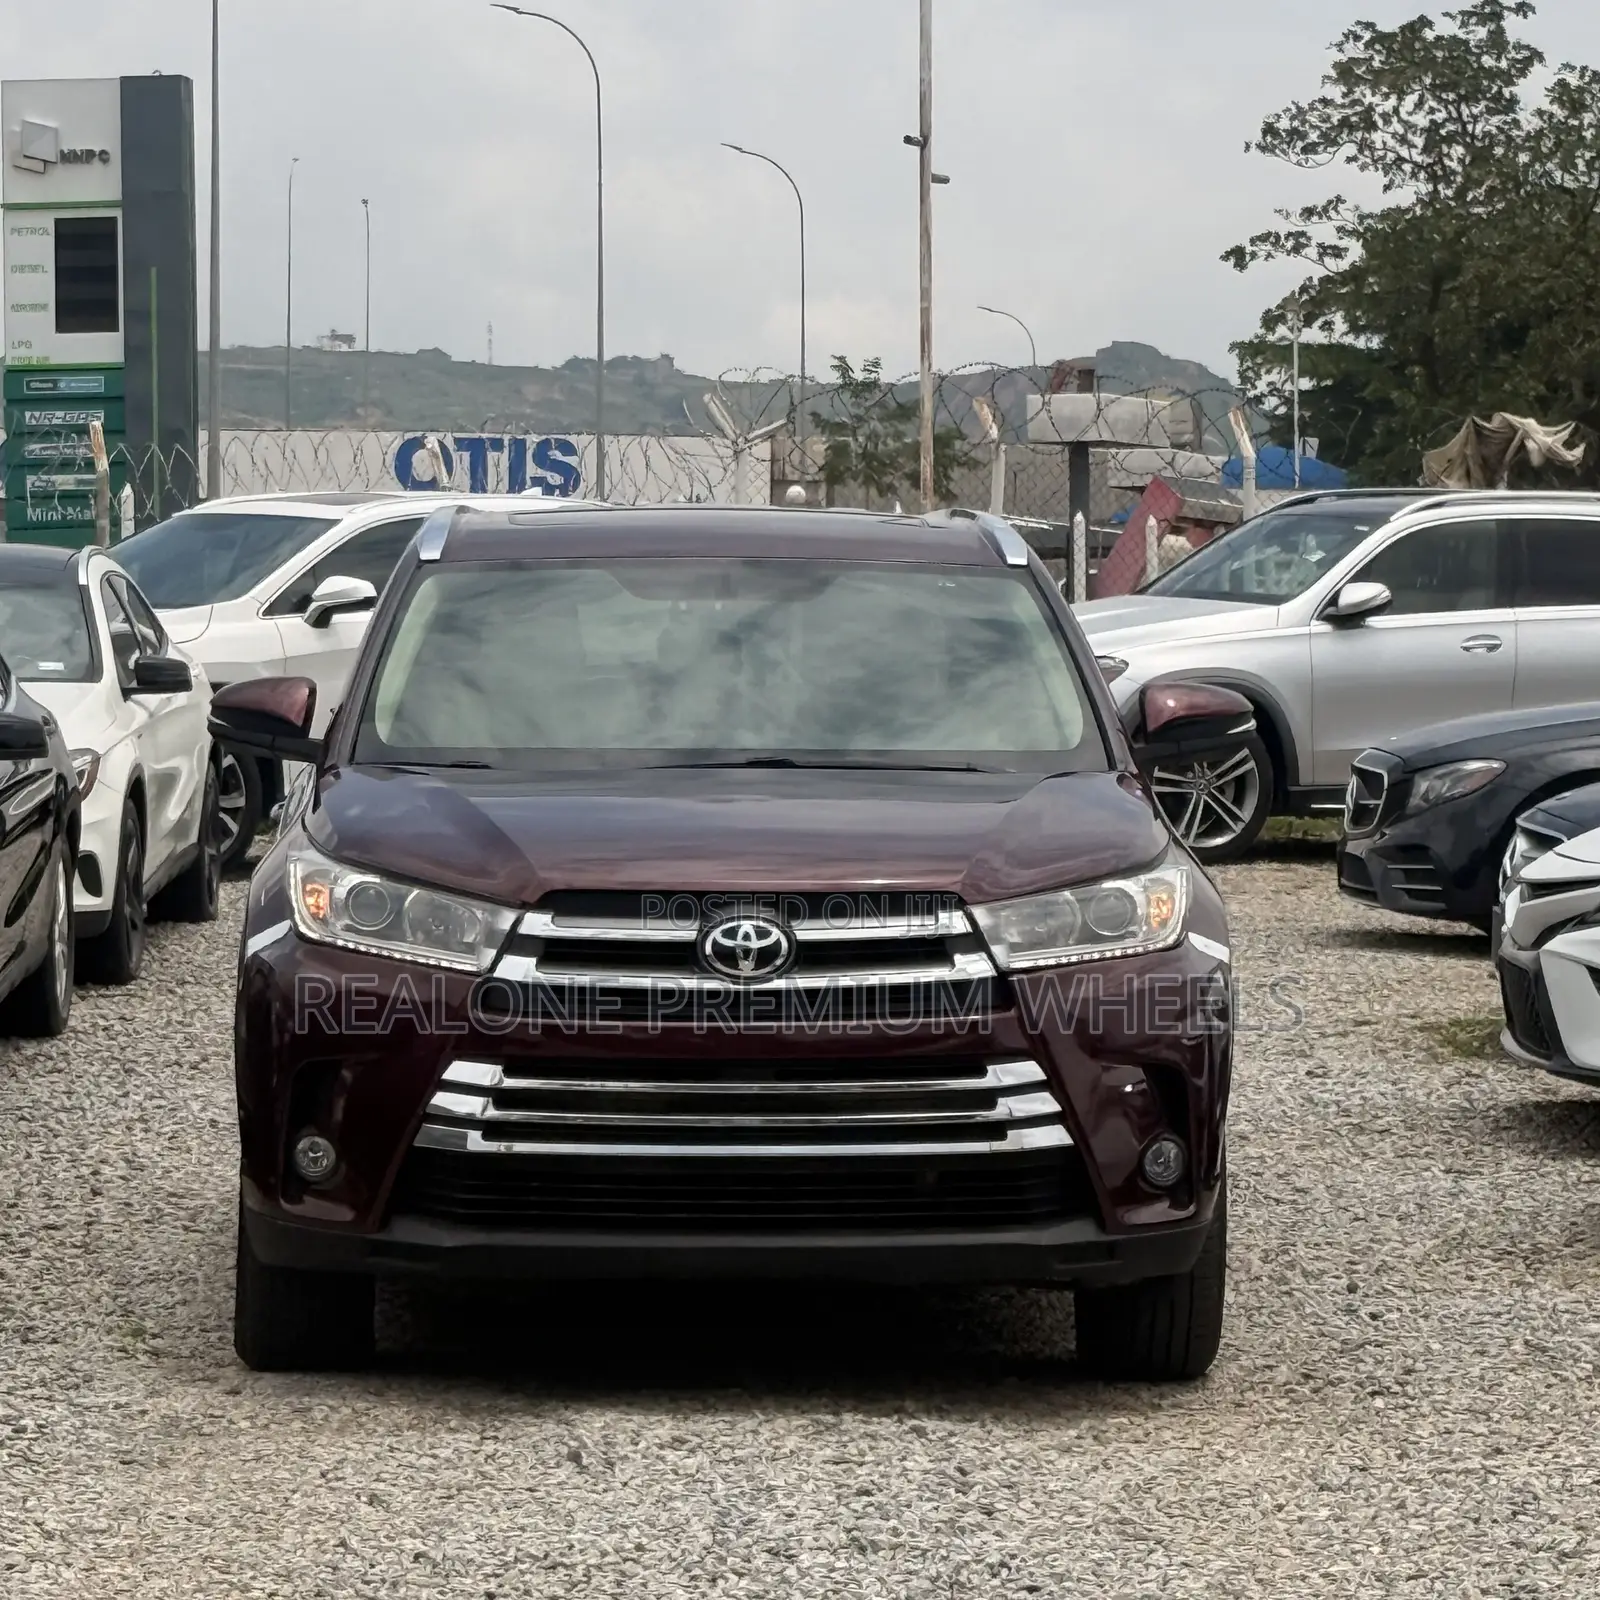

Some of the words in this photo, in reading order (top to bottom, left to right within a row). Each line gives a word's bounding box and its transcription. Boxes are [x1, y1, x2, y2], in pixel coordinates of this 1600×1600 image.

[59, 149, 110, 164] NNPC
[10, 226, 50, 236] PETROL
[10, 264, 48, 274] DIESEL
[11, 340, 33, 350] LPG
[394, 436, 582, 497] OTIS
[27, 507, 61, 521] Mini
